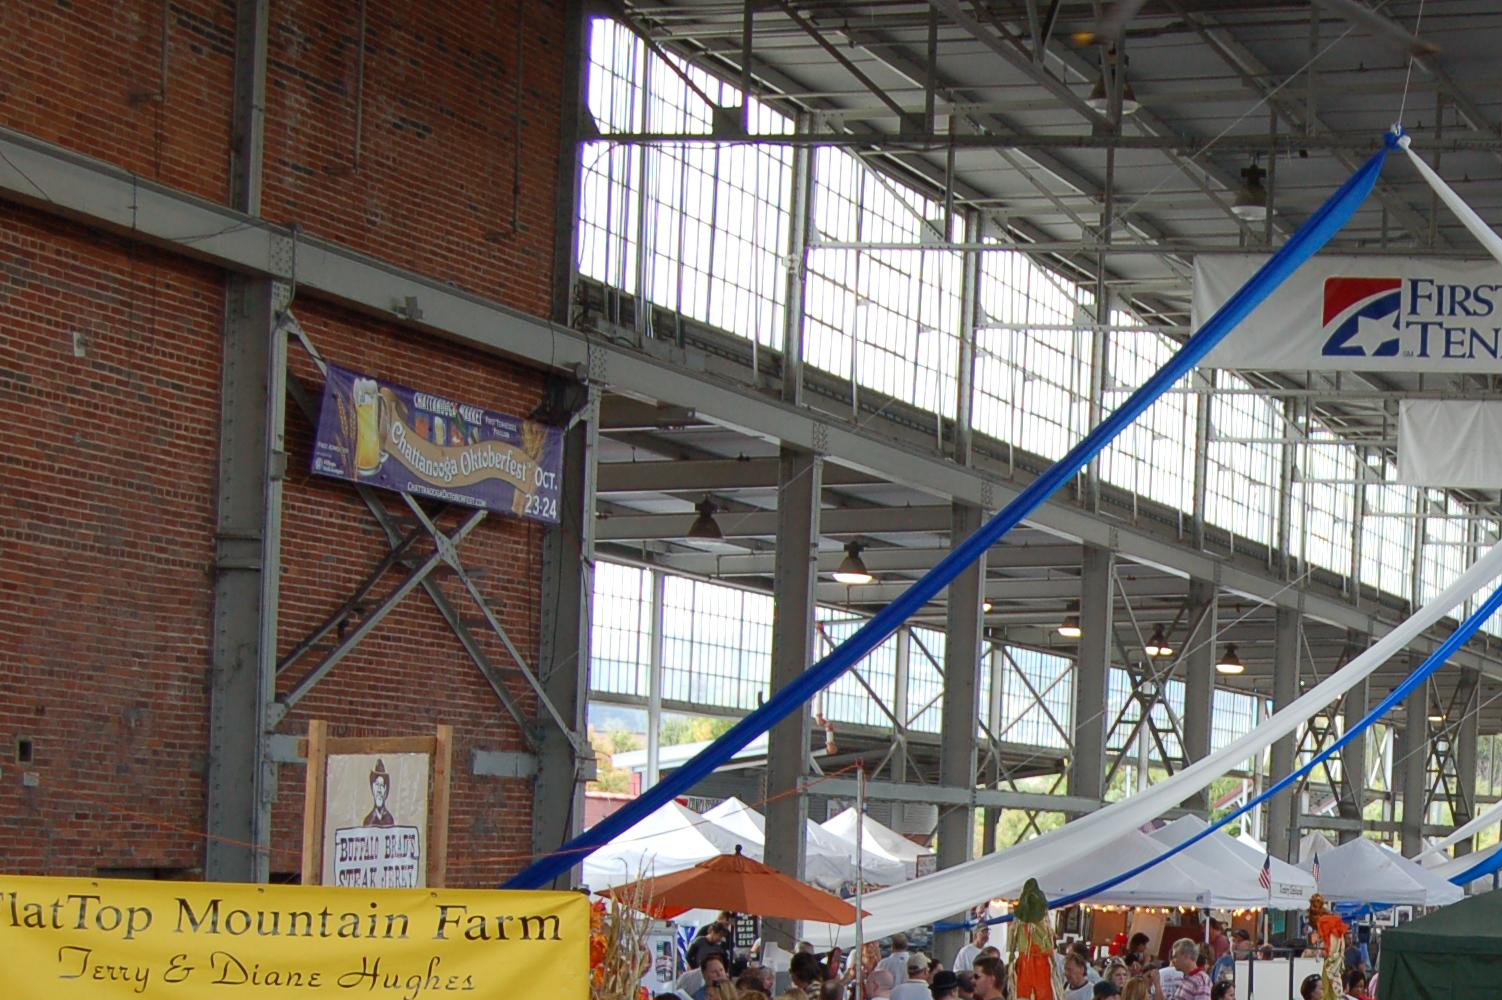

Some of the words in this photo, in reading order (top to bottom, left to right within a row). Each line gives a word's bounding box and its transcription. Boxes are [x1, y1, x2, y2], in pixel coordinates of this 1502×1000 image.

[391, 421, 458, 482] Chattanooga
[460, 444, 527, 481] Oktoberfest
[534, 466, 558, 491] OCT.
[524, 494, 557, 519] 23-24
[339, 836, 379, 862] BUFFALO
[384, 834, 416, 860] BRAD'S
[338, 866, 378, 888] STEAK
[0, 891, 153, 940] latTop
[174, 897, 410, 940] Mountain
[431, 904, 563, 941] Farm
[57, 945, 150, 994] Terry
[163, 953, 195, 983] &
[210, 951, 322, 988] Diane
